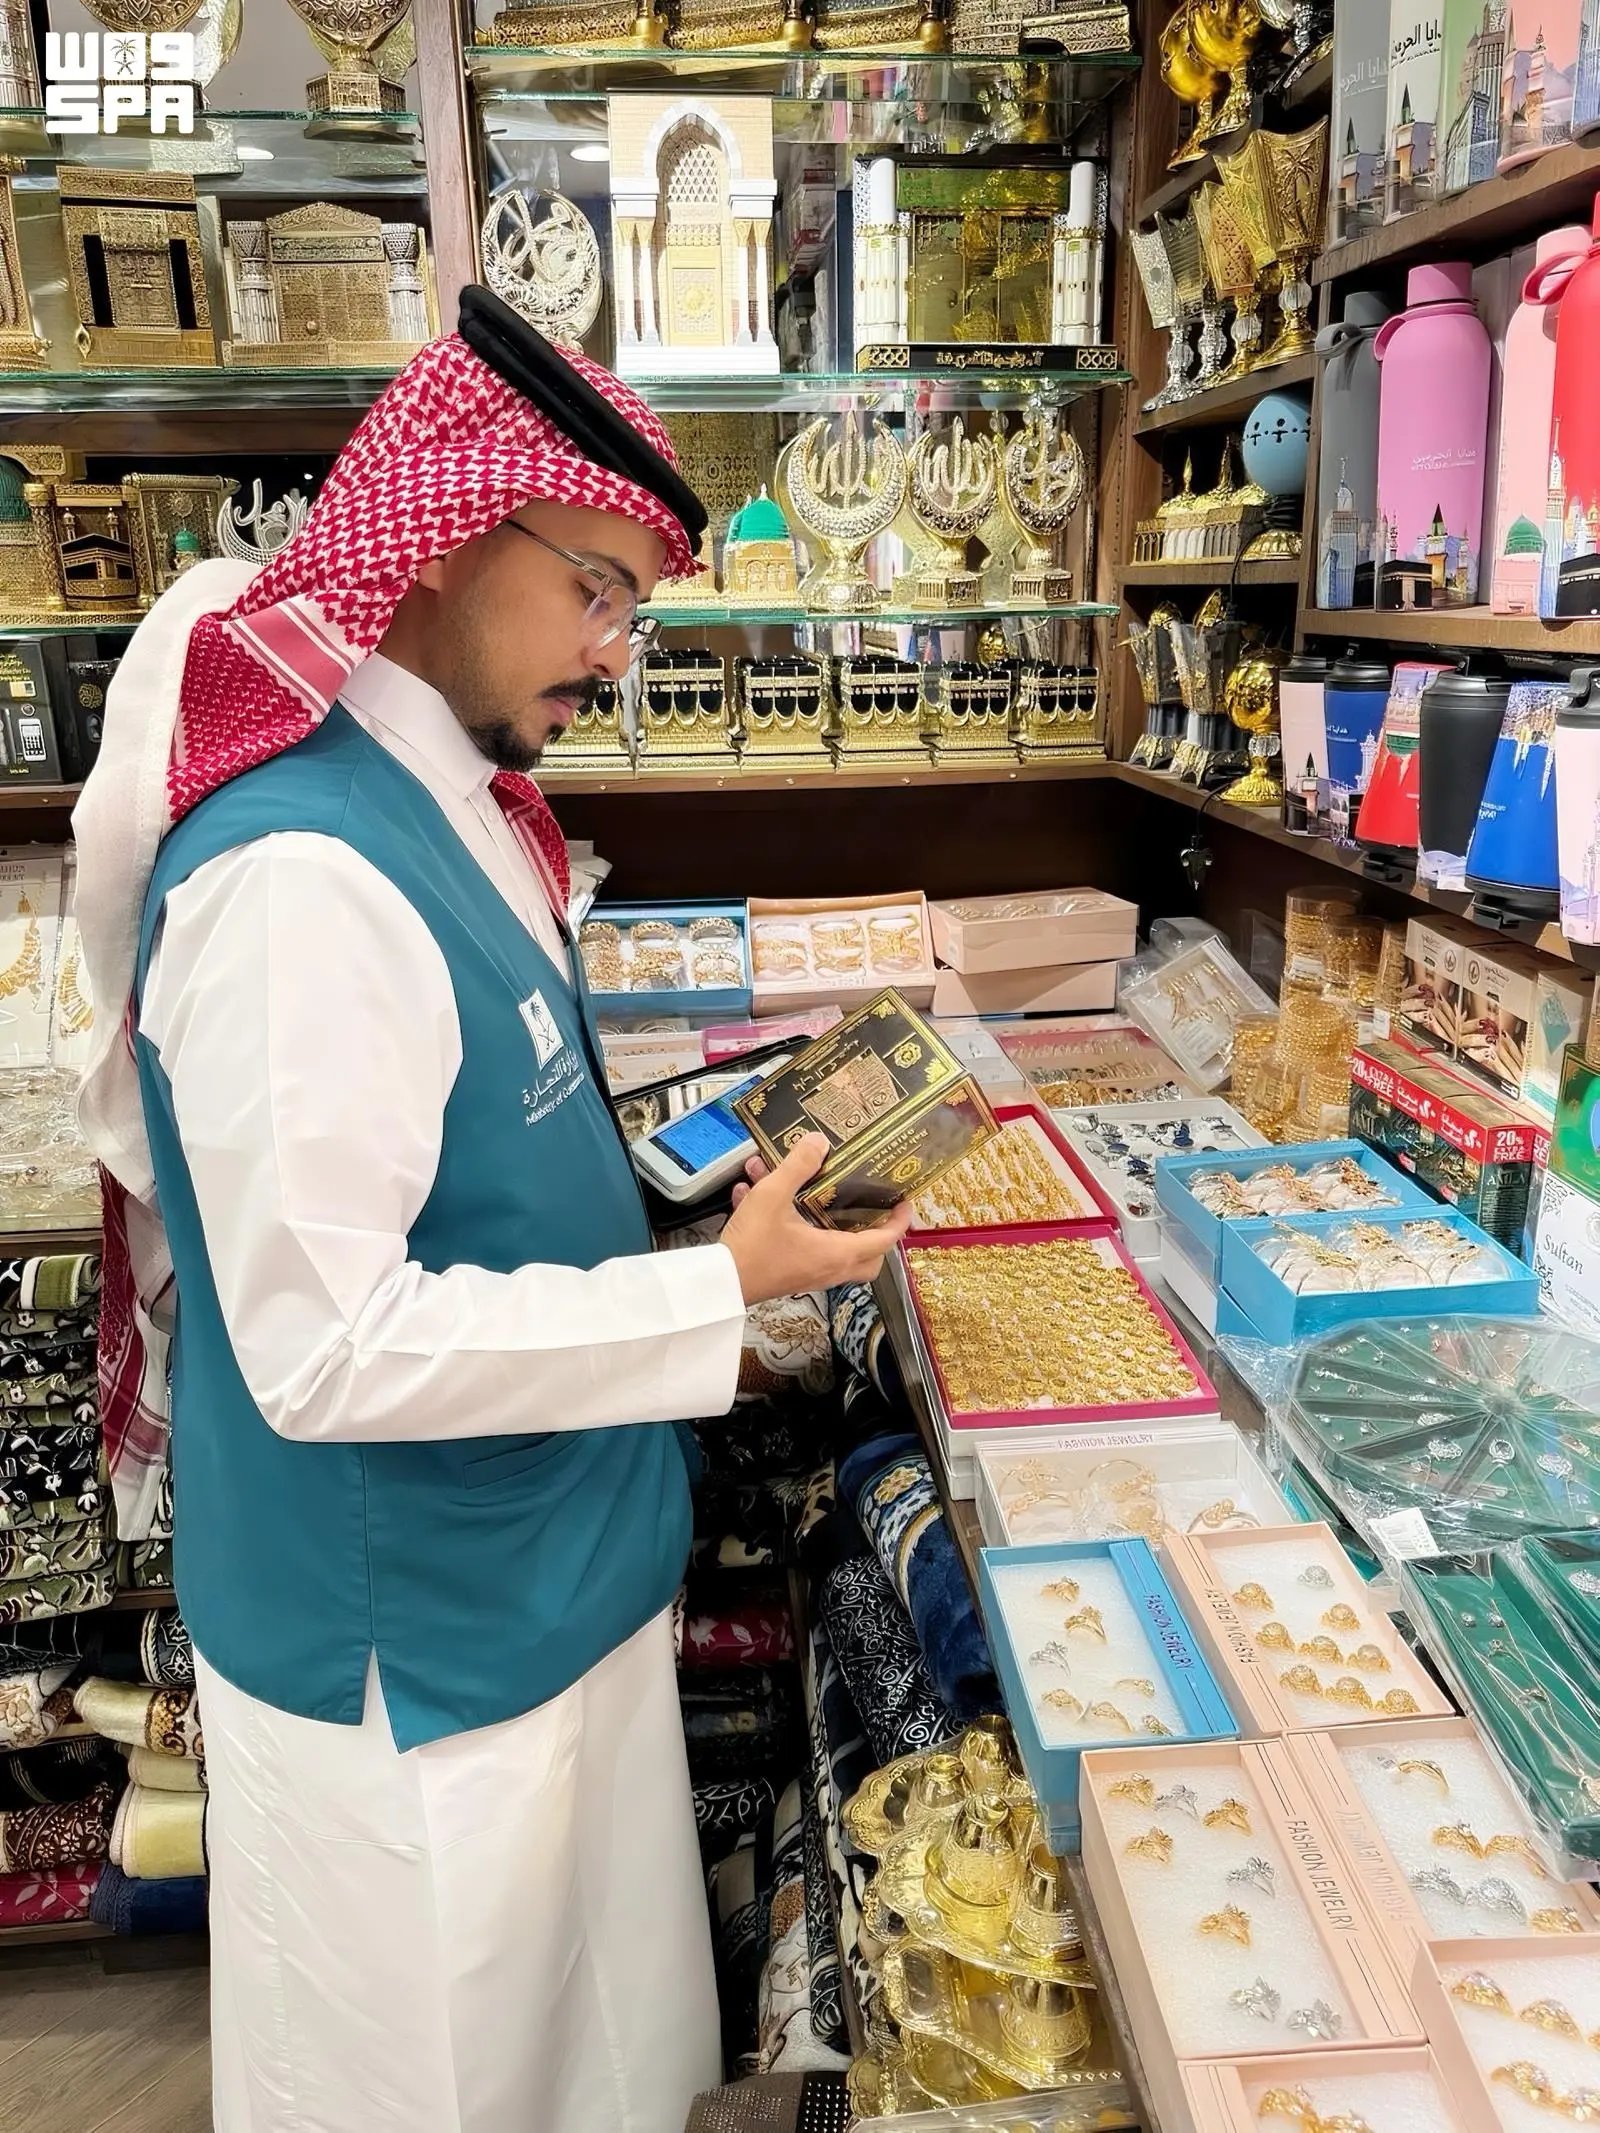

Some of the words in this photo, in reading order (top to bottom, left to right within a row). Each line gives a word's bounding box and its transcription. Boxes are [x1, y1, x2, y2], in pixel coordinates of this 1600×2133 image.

[526, 1100, 557, 1127] Ministry
[1496, 1130, 1525, 1147] 20%
[1493, 1151, 1526, 1163] FREE
[1543, 1233, 1584, 1275] Sultan
[1058, 1436, 1106, 1452] FASHION
[1106, 1432, 1155, 1447] JEWELRY
[1143, 1593, 1173, 1631] FASHION
[1159, 1630, 1195, 1671] JEWELRY
[1223, 1622, 1258, 1664] FASHION
[1284, 1819, 1327, 1875] FASHION
[1307, 1873, 1359, 1933] JEWELRY
